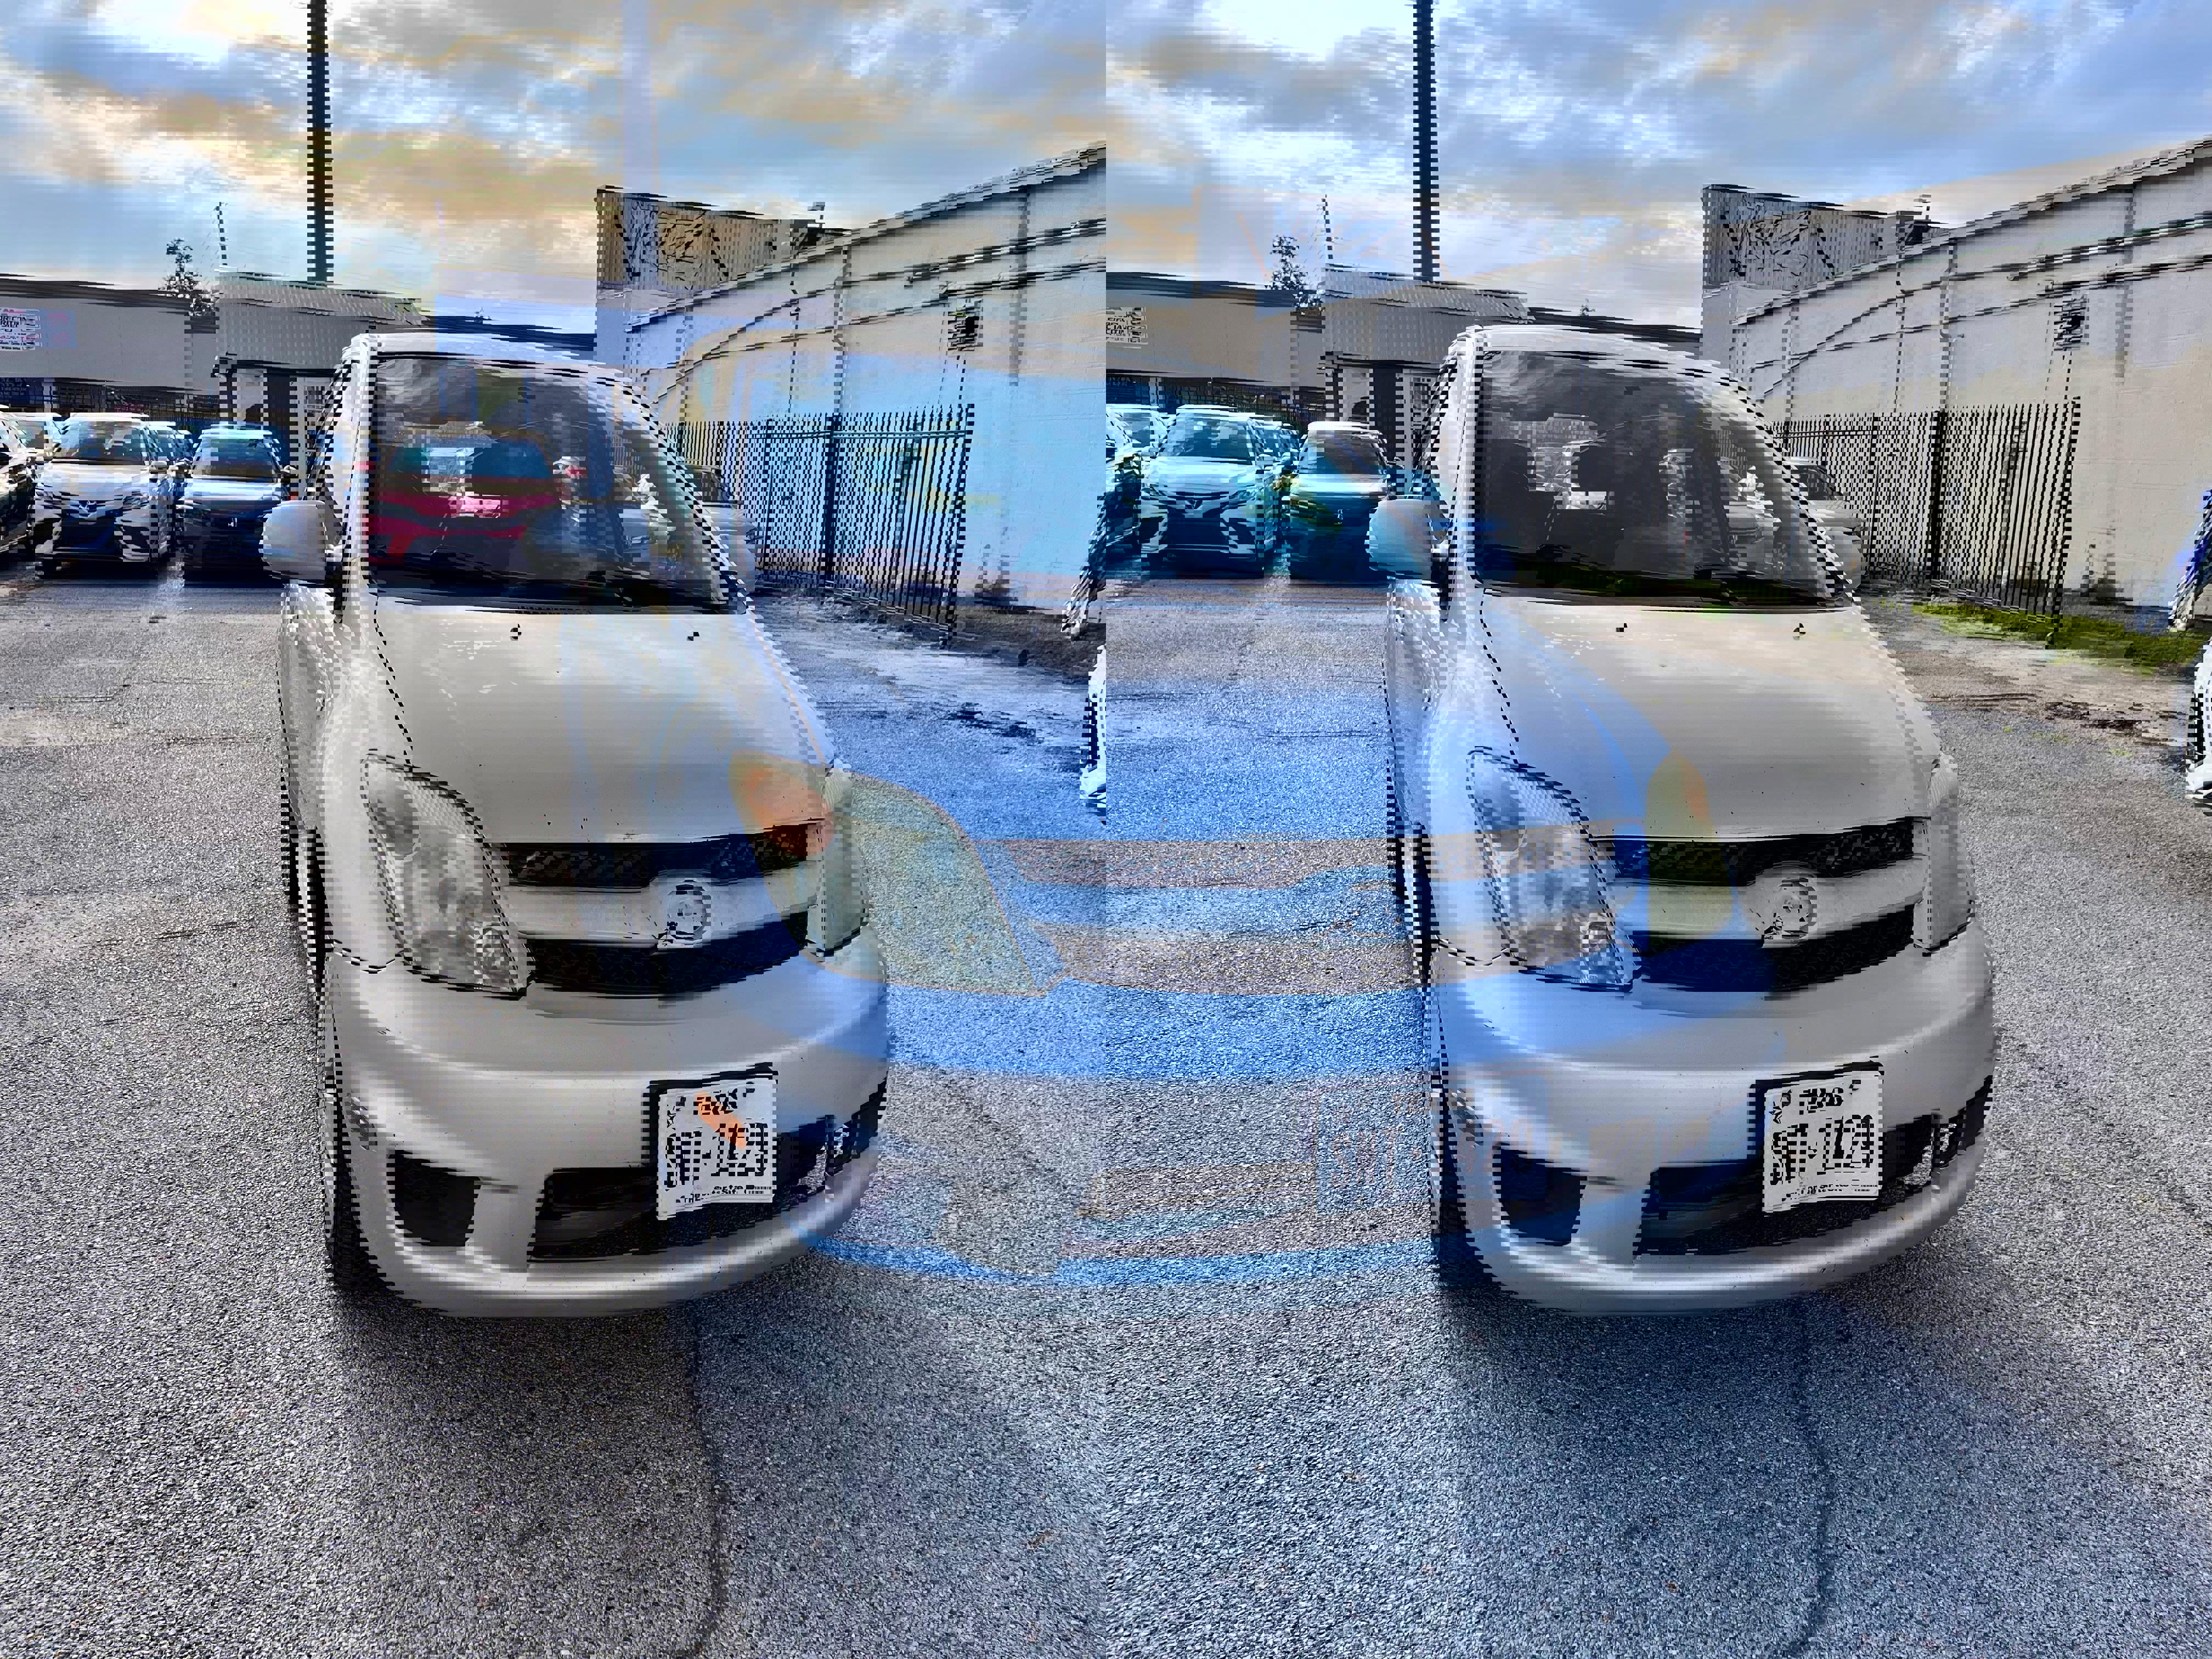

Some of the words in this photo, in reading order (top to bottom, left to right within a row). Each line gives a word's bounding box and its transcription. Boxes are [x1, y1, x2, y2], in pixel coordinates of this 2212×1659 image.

[1390, 1087, 1475, 1115] TEXAS
[1330, 1126, 1402, 1188] SNT
[1429, 1118, 1532, 1176] 1429
[1375, 1192, 1394, 1200] The
[1397, 1187, 1421, 1197] Lone
[1424, 1185, 1446, 1194] Star
[1449, 1183, 1481, 1192] State
